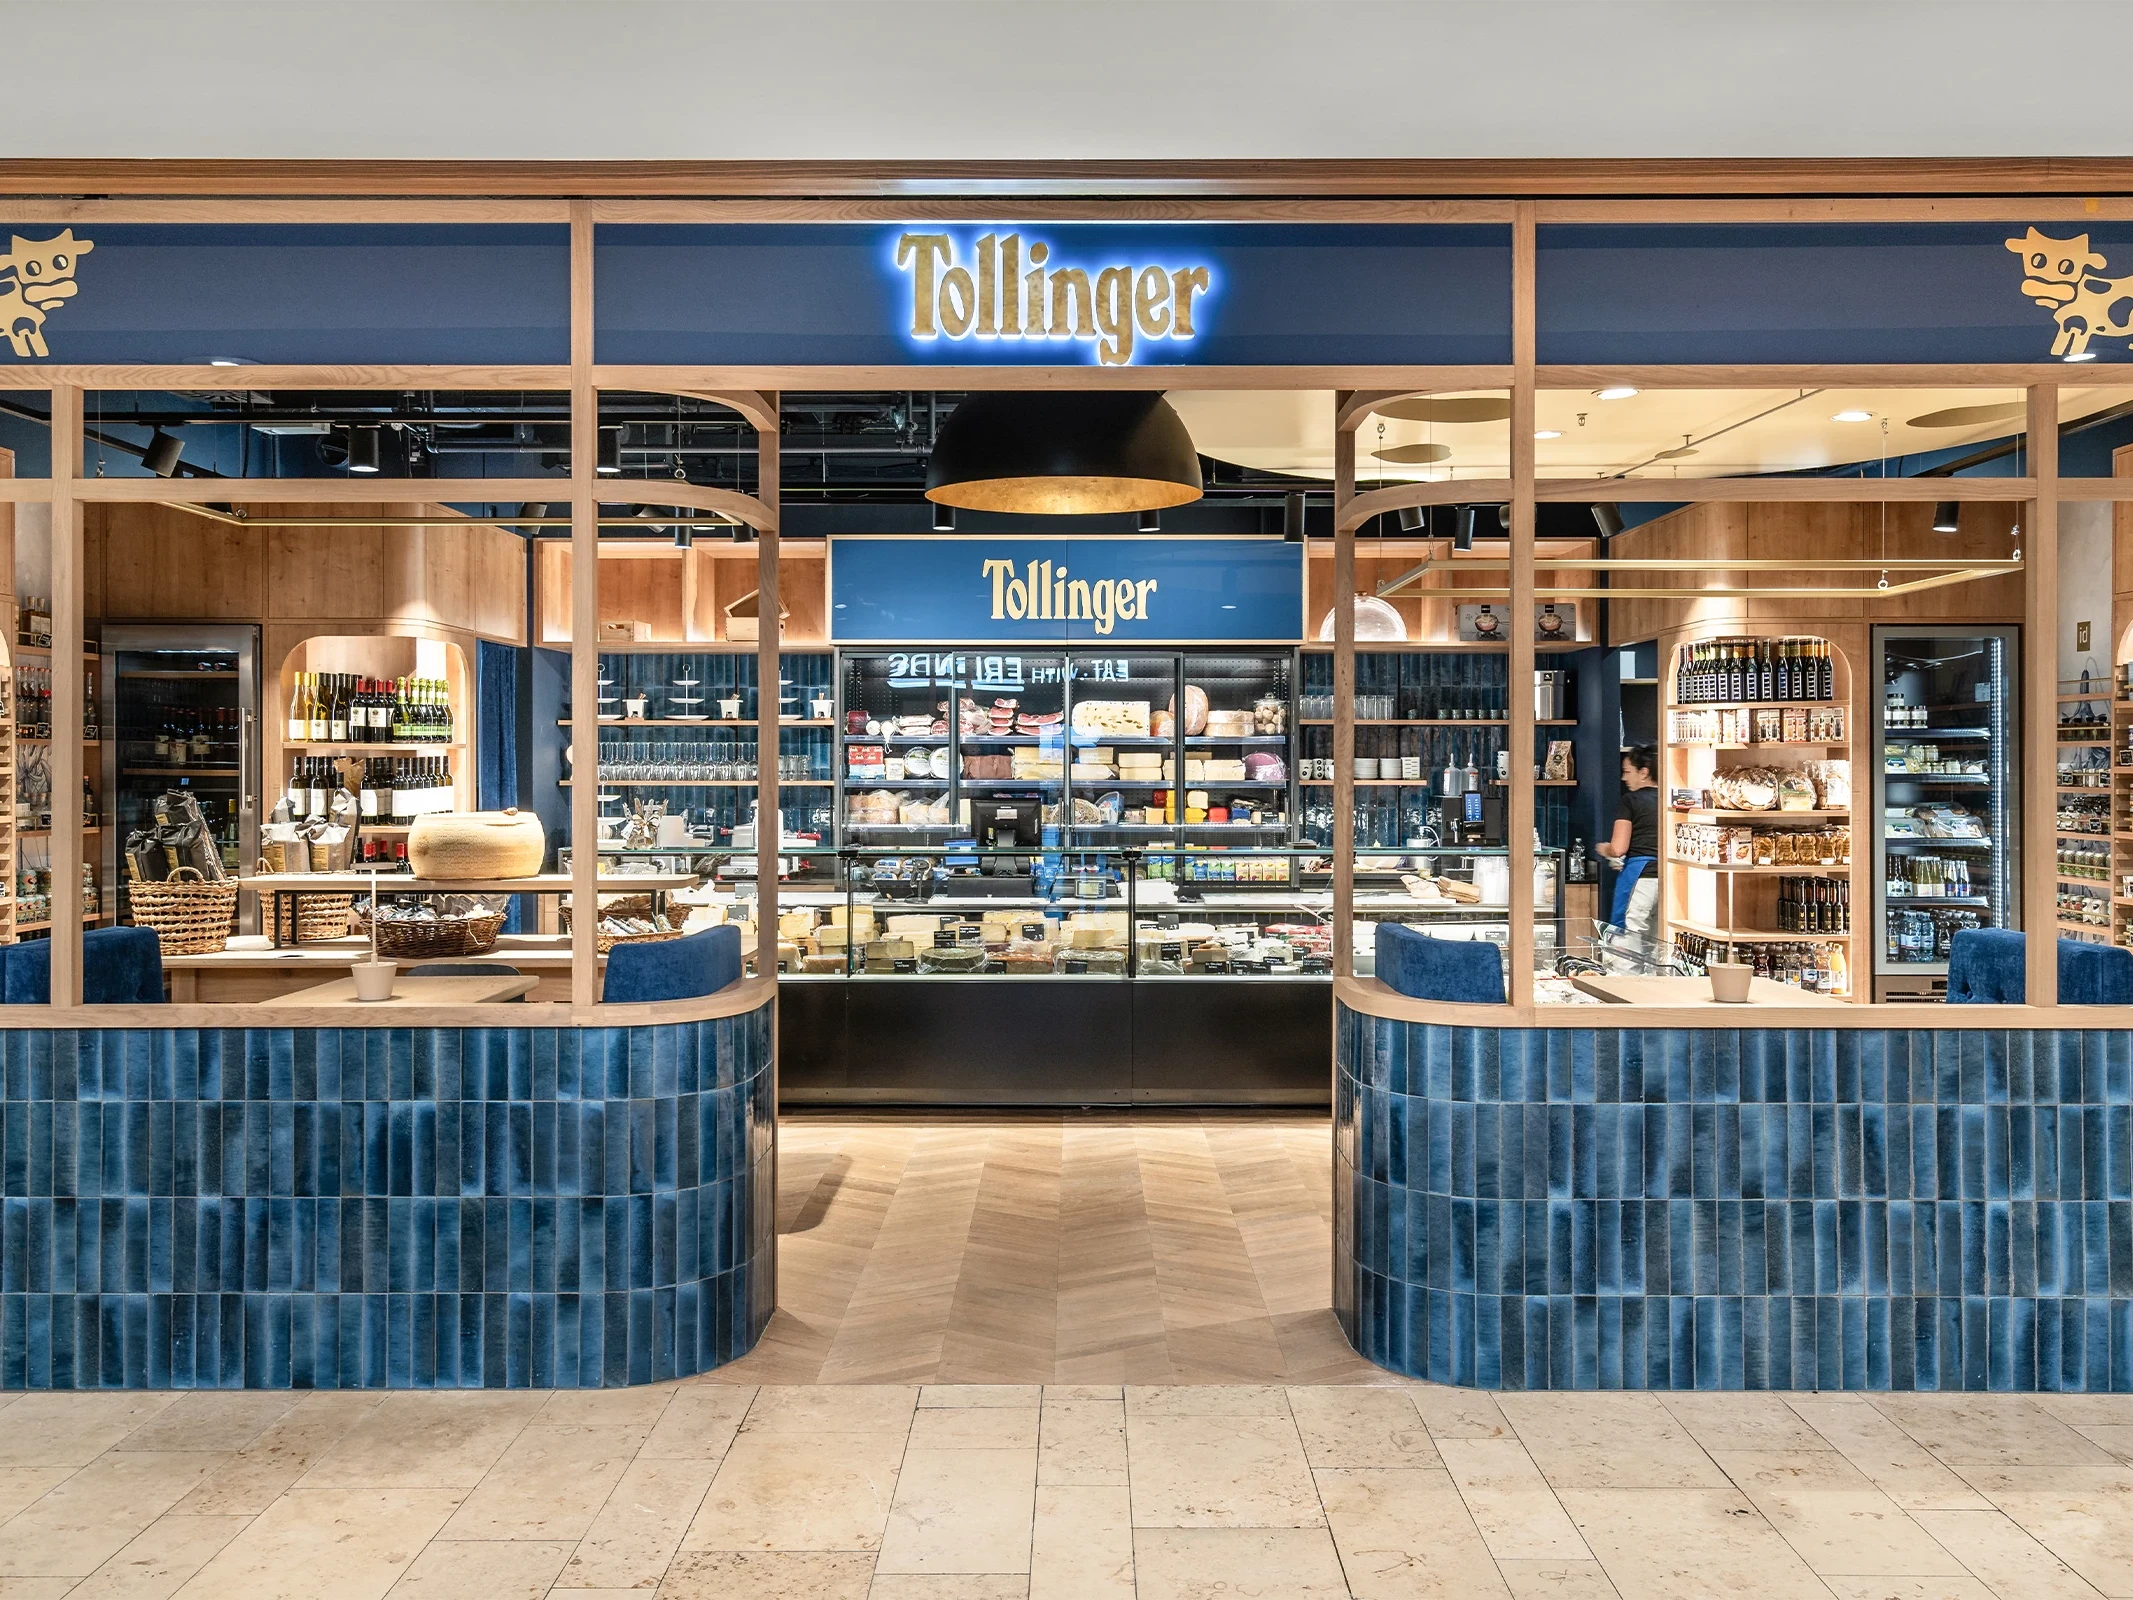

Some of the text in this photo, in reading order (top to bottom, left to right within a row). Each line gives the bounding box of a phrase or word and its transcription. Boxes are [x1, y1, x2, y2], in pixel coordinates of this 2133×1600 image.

[896, 231, 1211, 366] Tollinger
[983, 559, 1157, 635] Tollinger
[2079, 626, 2088, 643] id
